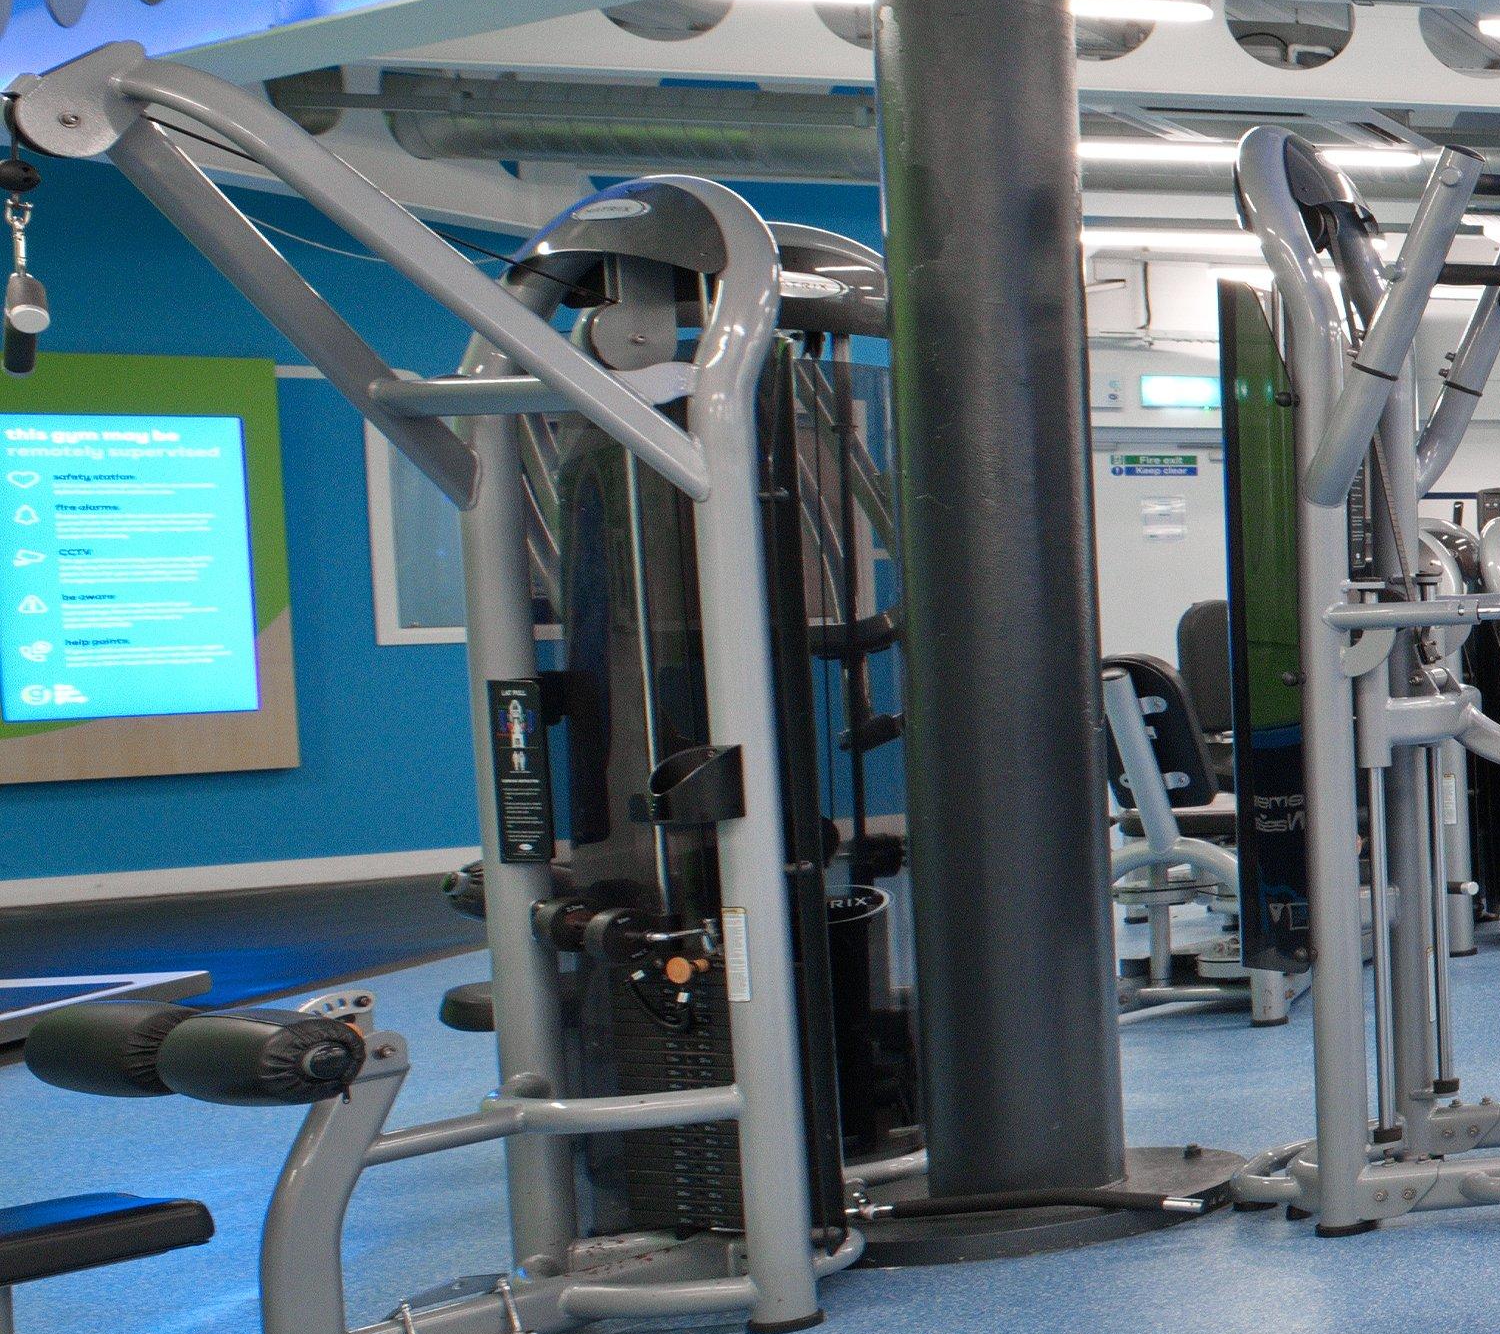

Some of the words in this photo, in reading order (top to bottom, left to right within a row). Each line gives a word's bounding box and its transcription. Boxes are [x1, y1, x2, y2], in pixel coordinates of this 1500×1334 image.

[5, 428, 47, 441] this
[51, 431, 98, 444] gym
[101, 431, 149, 444] may
[152, 428, 180, 442] be
[1139, 456, 1161, 464] Fire
[1163, 456, 1184, 464] exit
[1136, 467, 1162, 476] Keep
[1162, 467, 1188, 475] clear
